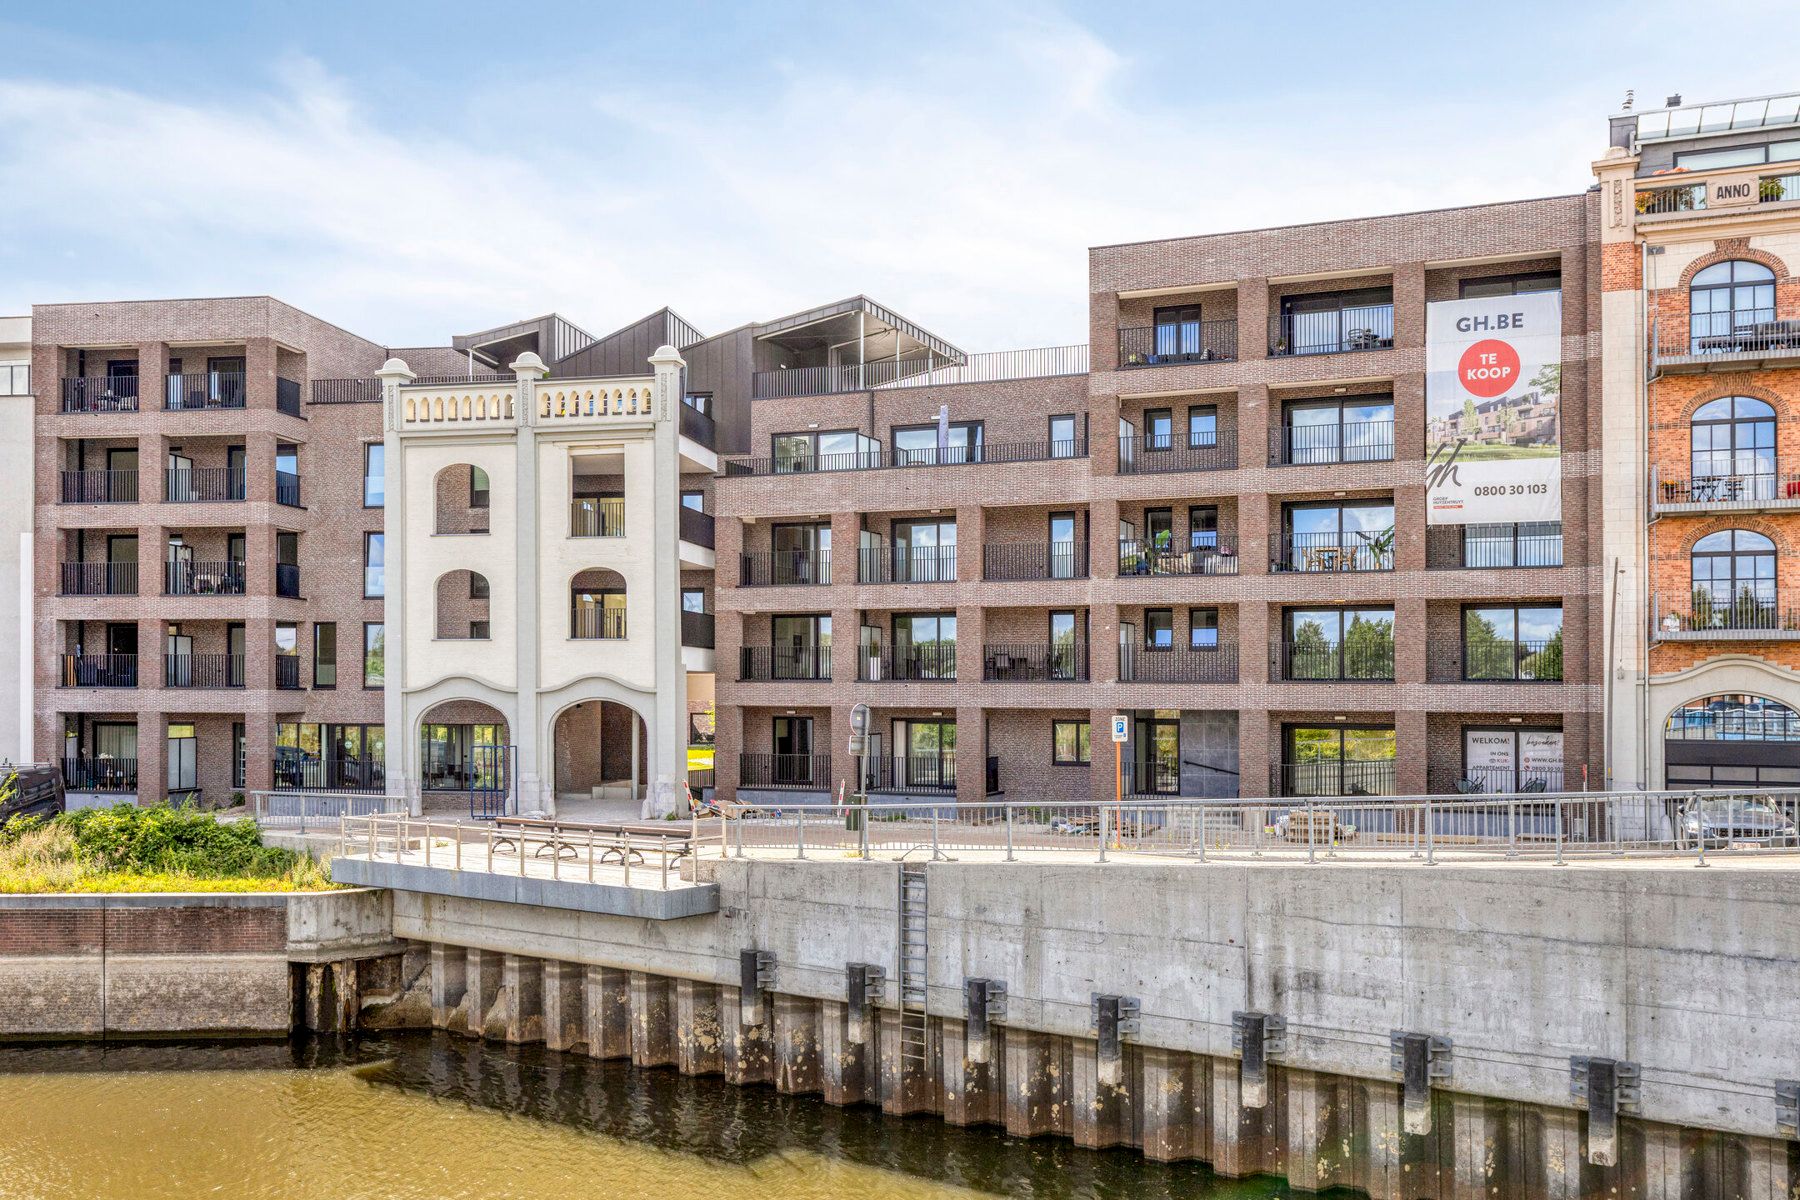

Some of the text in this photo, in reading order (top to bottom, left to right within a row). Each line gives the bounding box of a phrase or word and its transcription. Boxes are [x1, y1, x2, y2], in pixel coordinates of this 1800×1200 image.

[1716, 183, 1751, 200] ANNO
[1456, 312, 1524, 333] GH.BE
[1479, 353, 1497, 365] TE
[1467, 367, 1511, 380] KOOP
[1474, 484, 1547, 496] 0800 30 103
